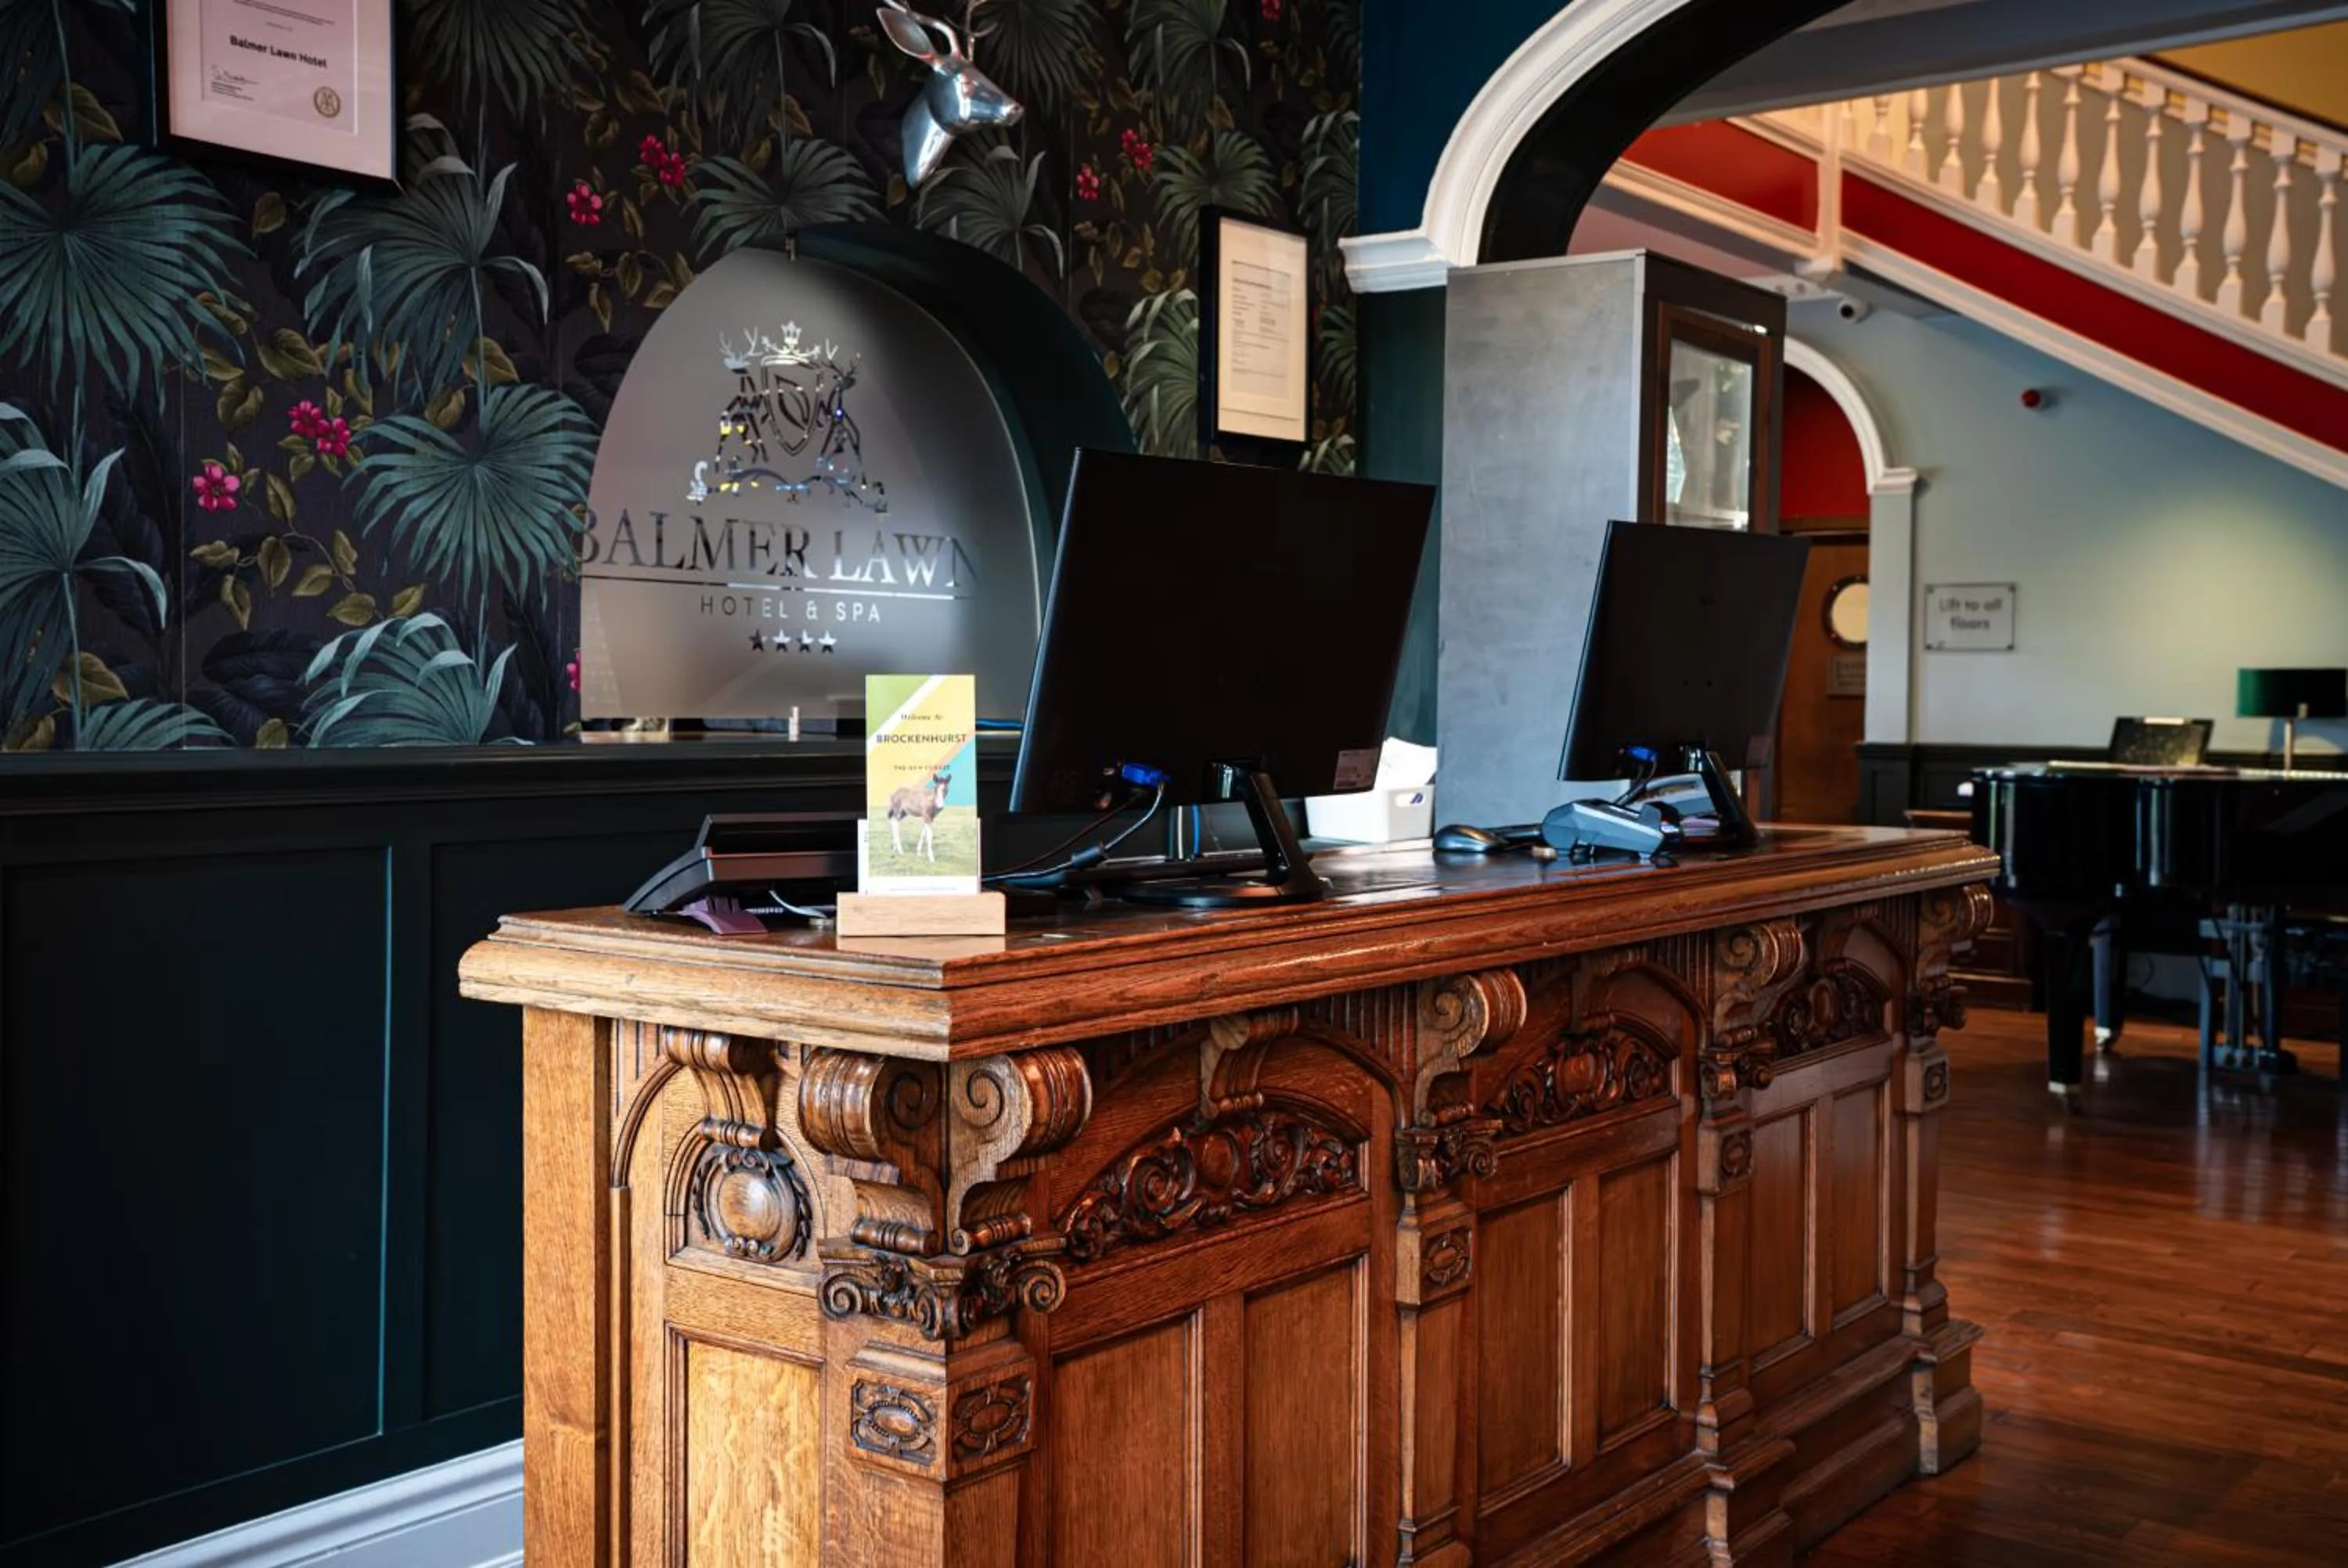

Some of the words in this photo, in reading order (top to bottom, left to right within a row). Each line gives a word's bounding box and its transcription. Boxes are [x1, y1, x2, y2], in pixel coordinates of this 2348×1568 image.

[230, 34, 267, 53] Balmer
[270, 45, 297, 61] Lawn
[299, 52, 327, 69] Hotel
[582, 506, 819, 579] BALMER
[700, 595, 788, 620] HOTEL
[805, 600, 818, 620] &
[835, 601, 880, 623] SPA
[876, 733, 967, 743] BROCKENHURST
